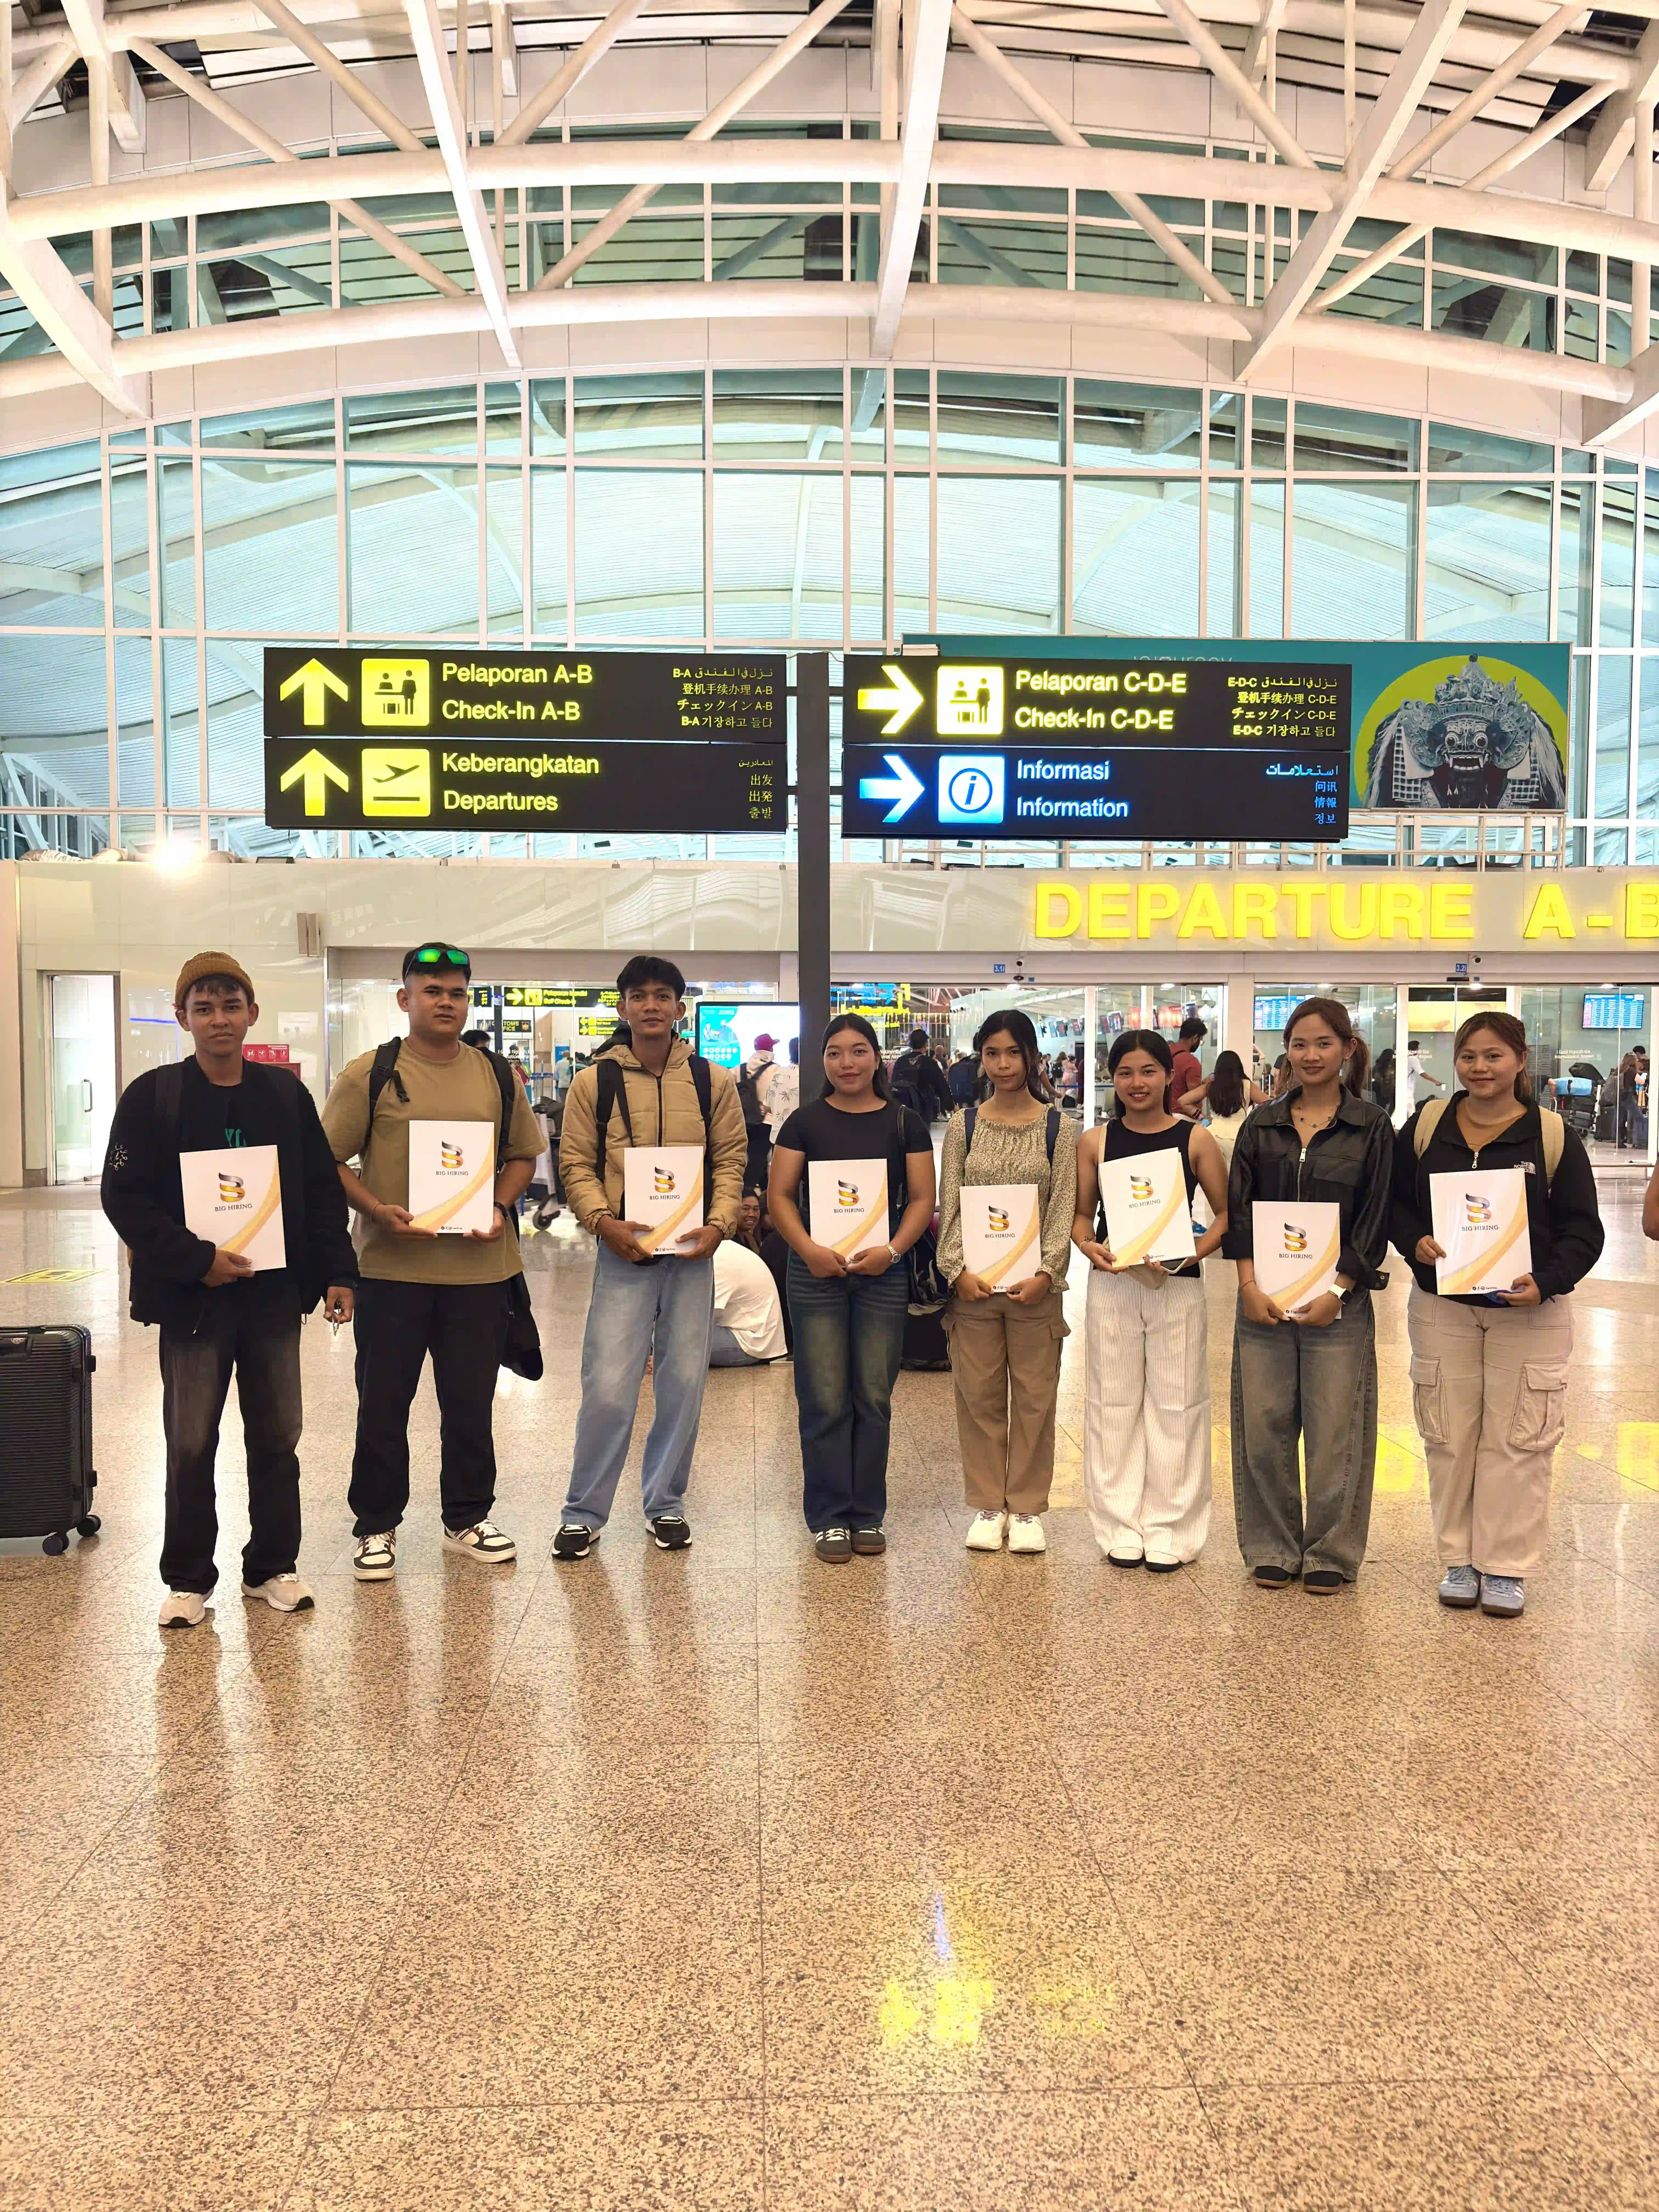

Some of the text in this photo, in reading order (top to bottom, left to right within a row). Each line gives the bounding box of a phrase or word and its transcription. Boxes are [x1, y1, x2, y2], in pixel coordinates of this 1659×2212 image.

[443, 663, 592, 686] Pelaporan A-B
[673, 668, 691, 678] B-A
[683, 683, 773, 695] 登机手续办理 A-B
[1016, 670, 1186, 695] Pelaporan C-D-E
[1228, 677, 1257, 688] E-D-C
[1237, 691, 1337, 704] 登机手续办理 C-D-E
[442, 699, 580, 721] Check-In A-B
[677, 699, 773, 712] チェックイン A-B
[1015, 707, 1173, 729] Check-In C-D-E
[1232, 707, 1336, 720] チェックイン C-D-E
[681, 715, 772, 728] B-A 기장하고 들다
[1233, 725, 1335, 737] E-D-C 기장하고 들다
[443, 753, 599, 778] Keberangkatan
[1017, 759, 1110, 781] Informasi
[751, 774, 773, 785] 出发
[1316, 780, 1337, 792] 问讯
[444, 791, 558, 814] Departures
[749, 790, 772, 802] 出発
[1314, 796, 1337, 808] 情報
[749, 807, 772, 819] 출발
[1017, 796, 1129, 817] Information
[1315, 813, 1336, 824] 정보
[1035, 883, 1475, 939] DEPARTURE
